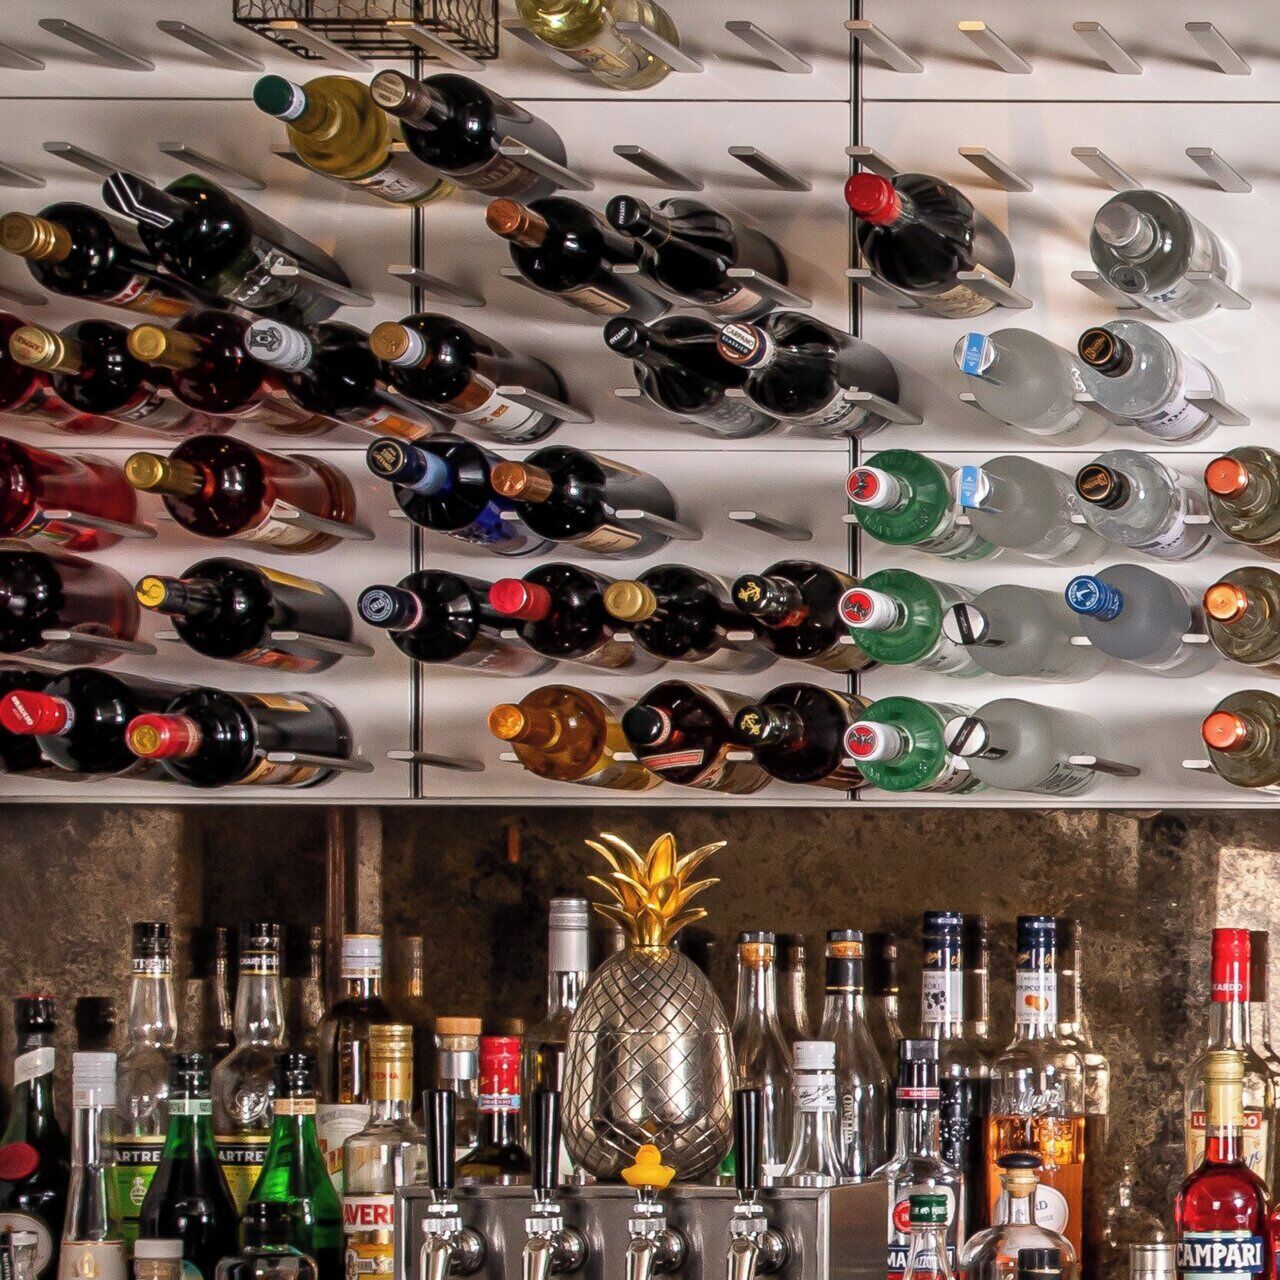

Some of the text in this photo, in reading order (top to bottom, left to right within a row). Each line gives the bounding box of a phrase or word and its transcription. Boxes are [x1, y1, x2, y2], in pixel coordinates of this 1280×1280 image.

[725, 326, 755, 347] CARPANO
[344, 1203, 395, 1225] AVER
[1176, 1242, 1263, 1268] CAMPARI
